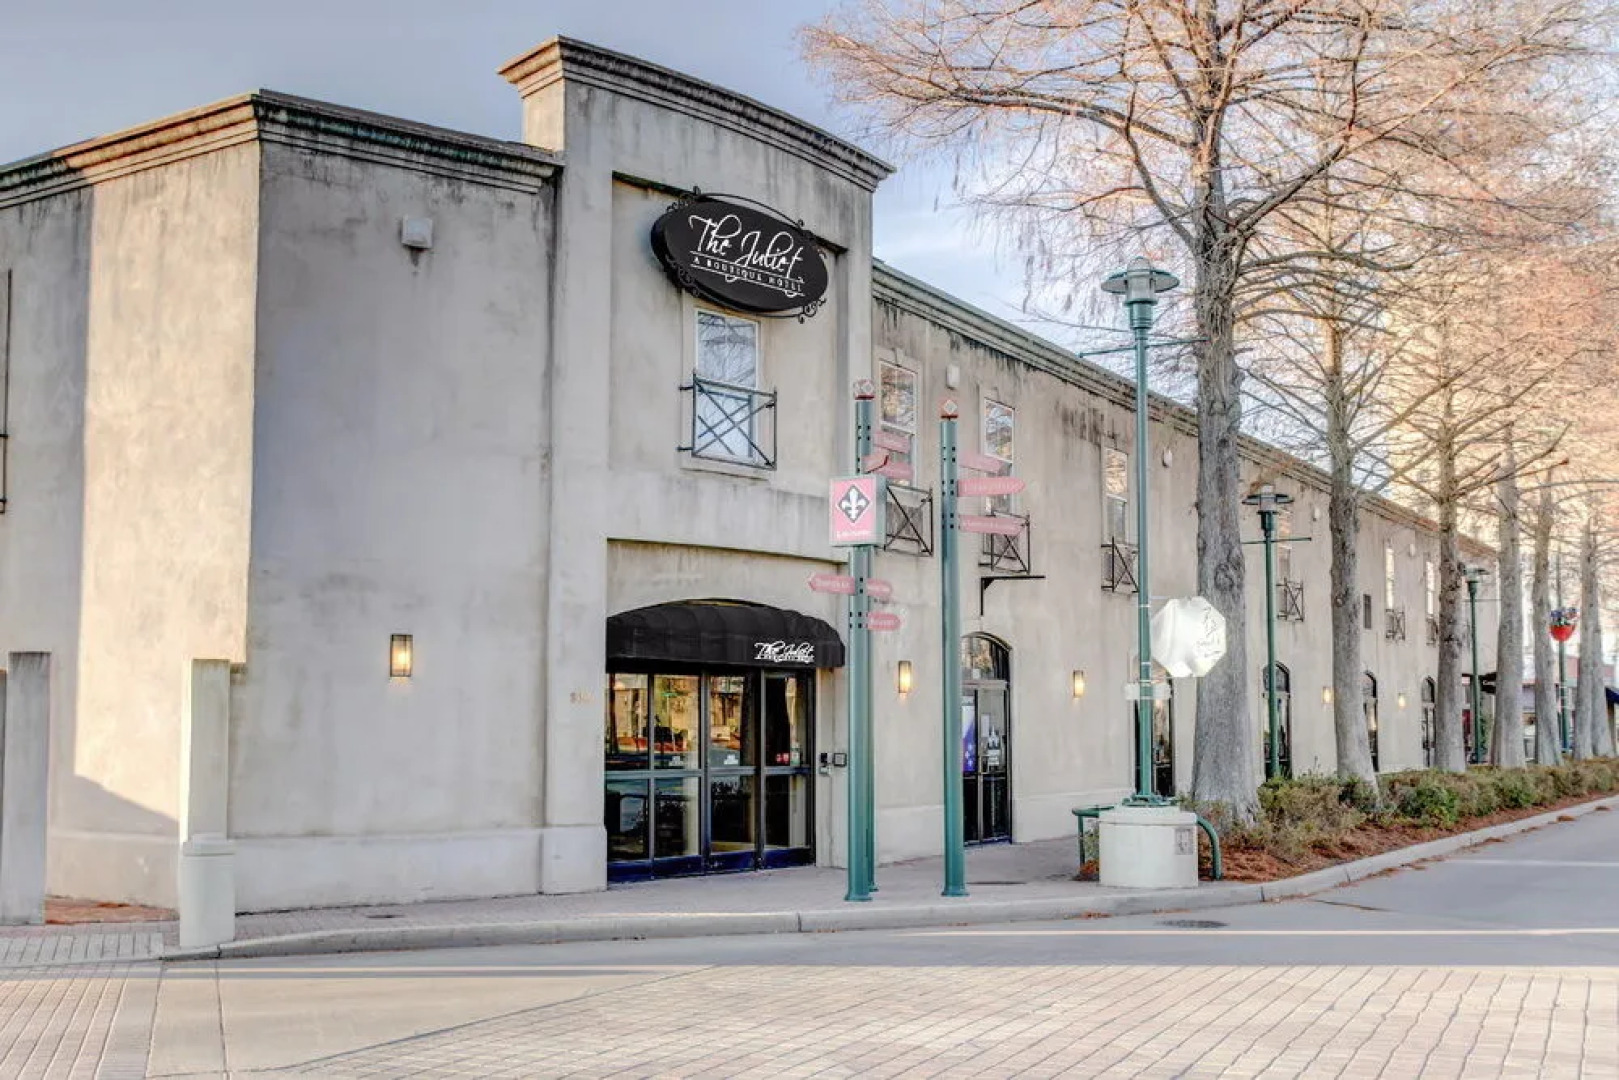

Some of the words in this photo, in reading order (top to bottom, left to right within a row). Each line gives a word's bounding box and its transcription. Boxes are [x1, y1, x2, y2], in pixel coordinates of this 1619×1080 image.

[689, 214, 742, 256] The
[734, 231, 803, 278] Juliet
[693, 256, 701, 265] A
[706, 259, 762, 281] BOUTIQUE
[754, 640, 785, 658] The
